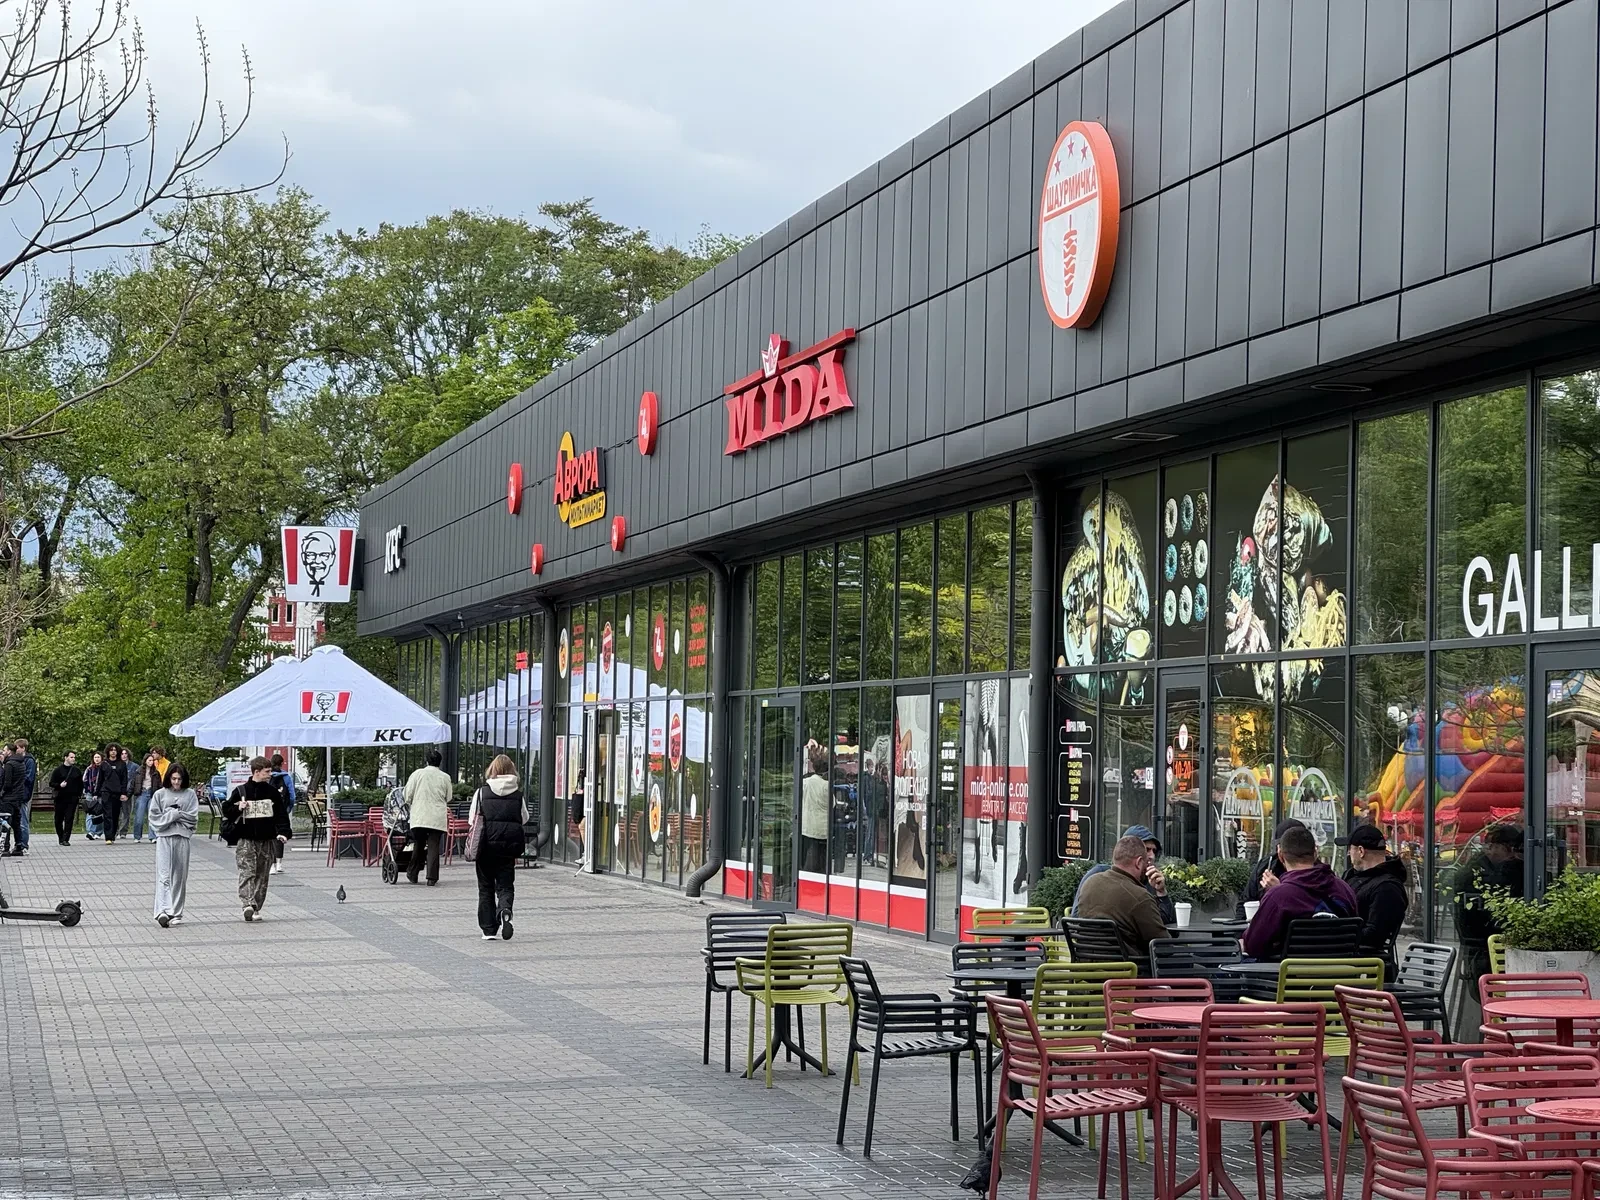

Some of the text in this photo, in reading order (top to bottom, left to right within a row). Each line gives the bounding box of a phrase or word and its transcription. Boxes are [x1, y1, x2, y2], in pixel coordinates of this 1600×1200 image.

[1046, 165, 1097, 212] ШАУРМИЧКА
[724, 348, 854, 456] MIDA
[553, 447, 602, 505] АВРОРА
[384, 524, 402, 574] KFC
[307, 714, 340, 722] KFC
[373, 728, 412, 742] KFC
[902, 750, 922, 770] НОВА
